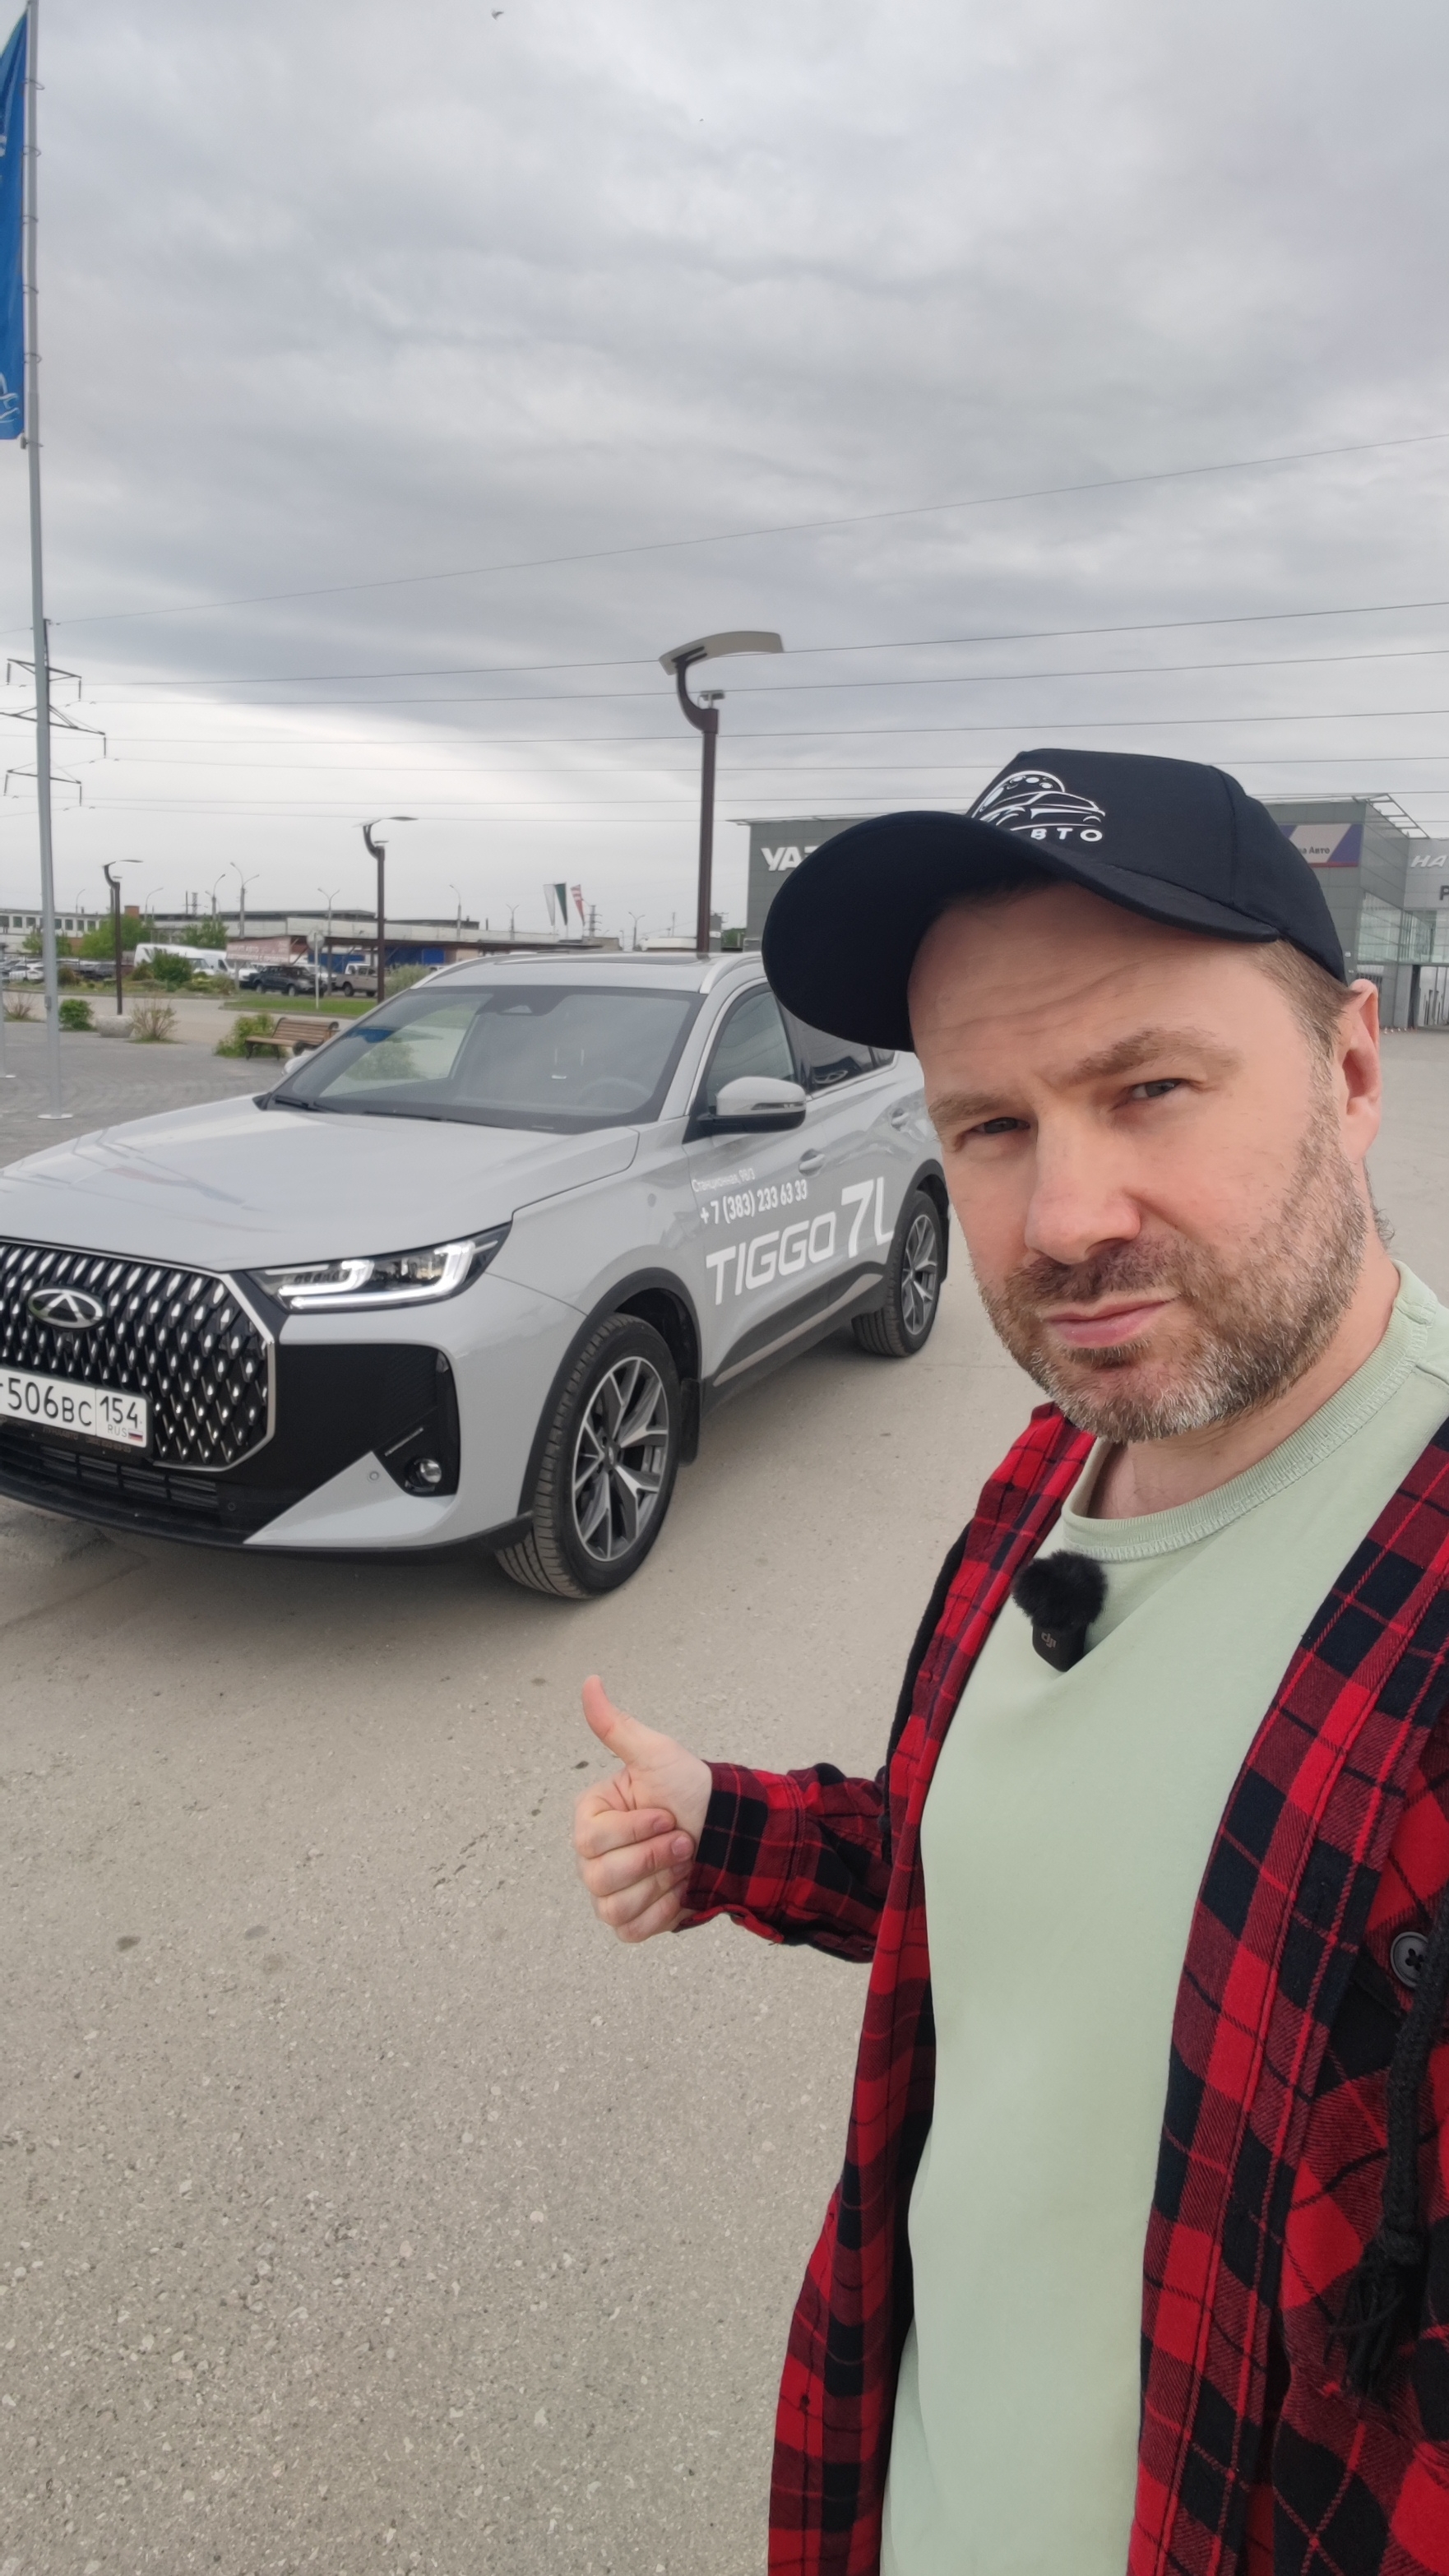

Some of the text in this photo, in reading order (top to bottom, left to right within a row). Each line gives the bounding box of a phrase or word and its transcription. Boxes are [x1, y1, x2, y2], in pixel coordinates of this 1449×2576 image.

[723, 1189, 756, 1225] (383)
[757, 1185, 778, 1212] 233
[780, 1182, 794, 1206] 63
[794, 1179, 808, 1202] 33
[706, 1176, 894, 1306] TIGGO 7L
[0, 1377, 138, 1429] 506ВС 154
[107, 1424, 127, 1438] RUS
[1040, 1632, 1057, 1648] dji
